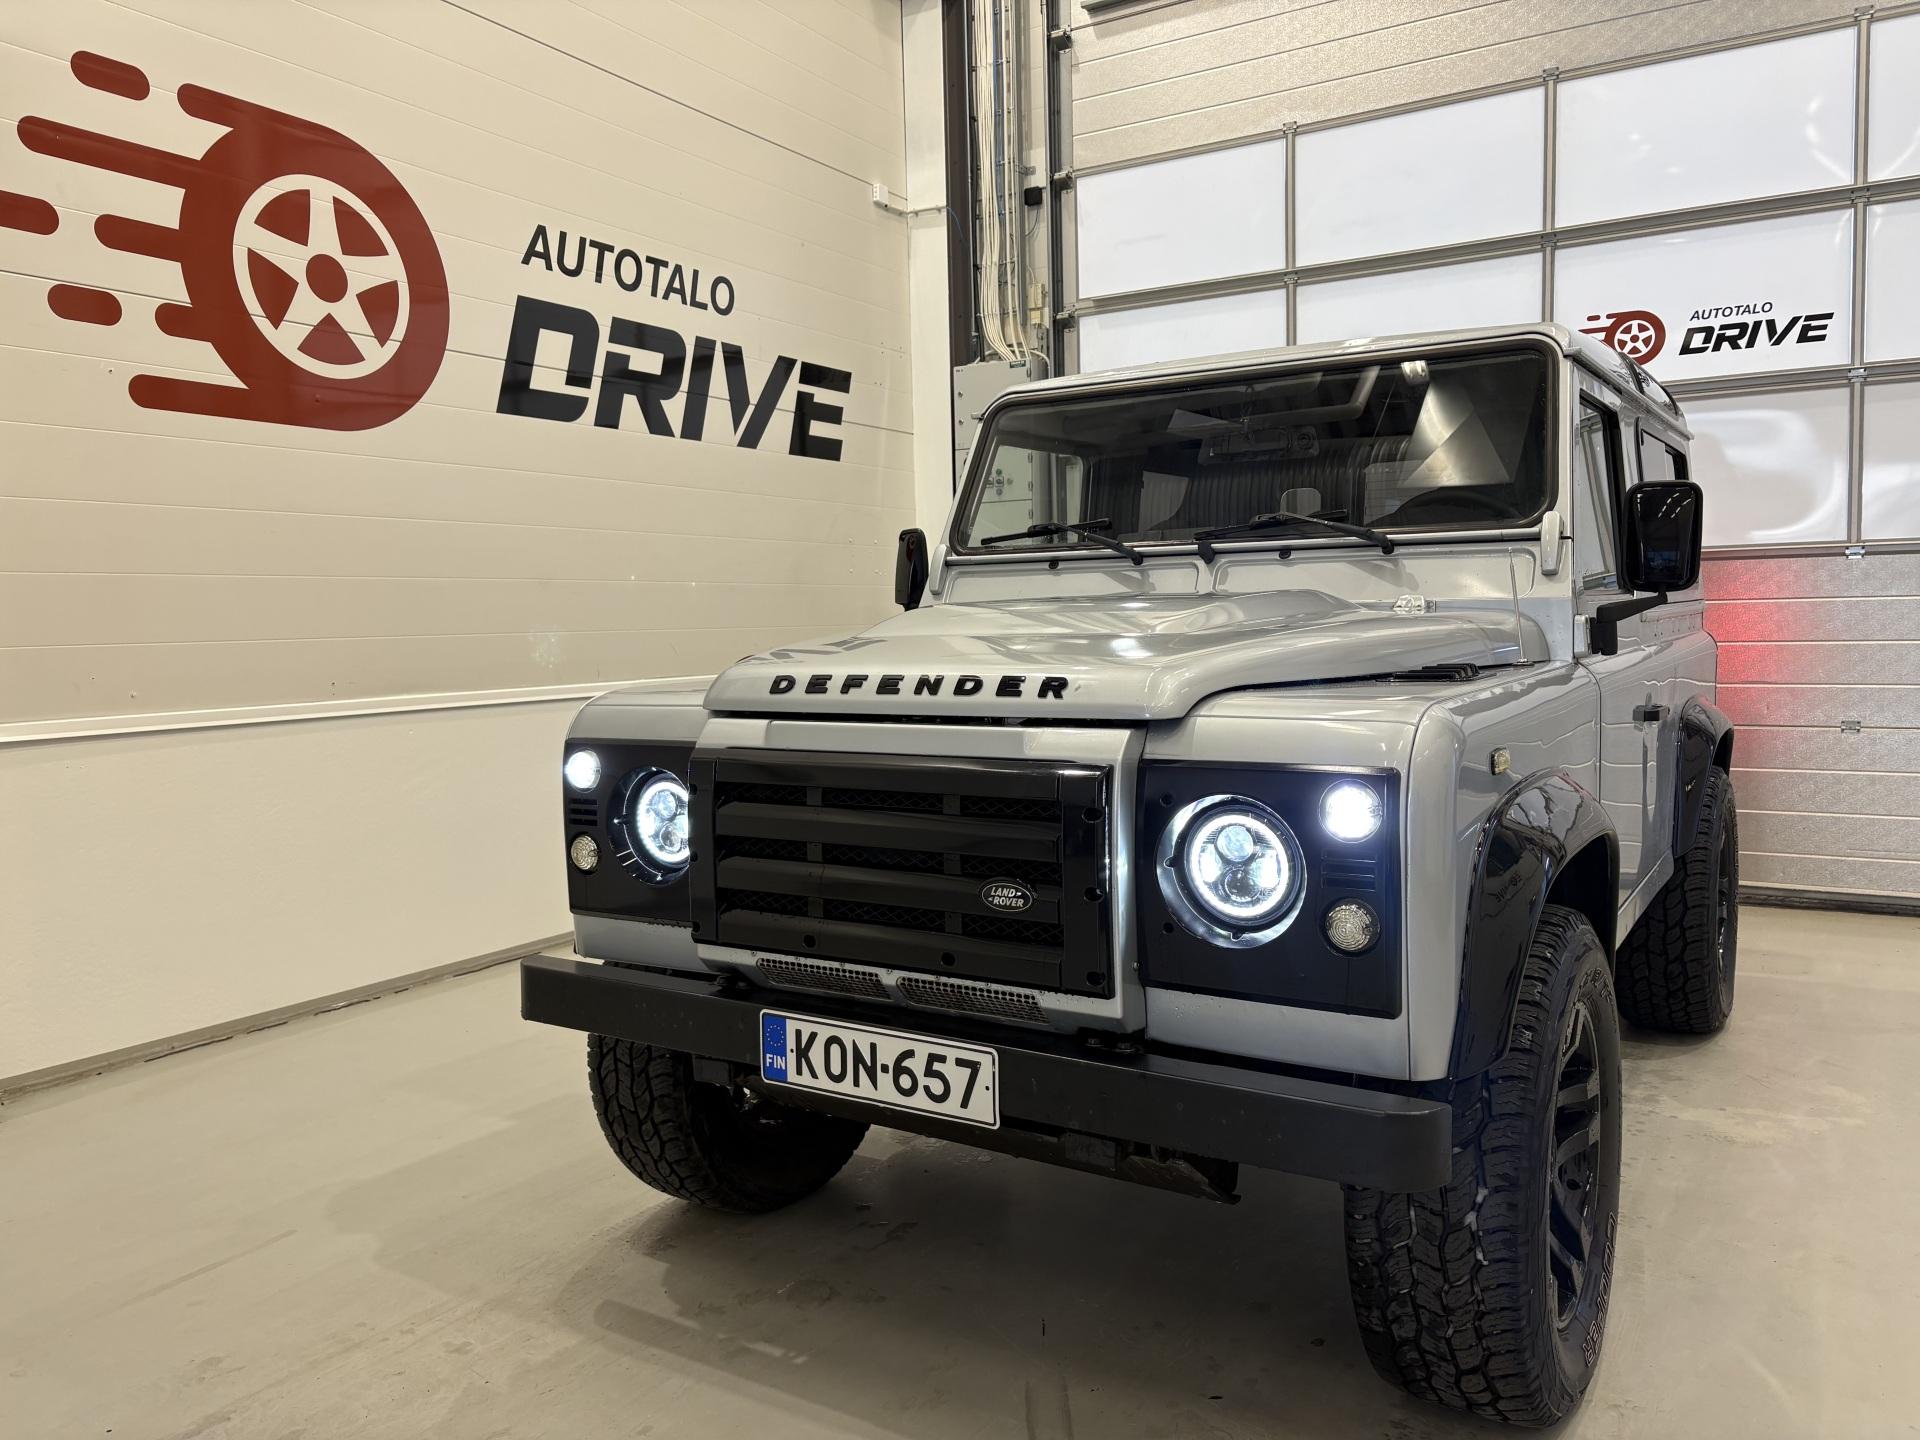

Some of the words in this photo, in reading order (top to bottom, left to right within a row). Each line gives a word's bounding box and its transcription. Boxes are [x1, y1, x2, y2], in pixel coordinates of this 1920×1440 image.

[521, 224, 735, 316] AUTOTALO
[1679, 312, 1835, 356] DRIVE
[1689, 301, 1773, 322] AUTOTALO
[496, 294, 852, 462] DRIVE
[769, 674, 1069, 699] DEFENDER
[766, 1053, 786, 1071] FIN
[795, 1028, 982, 1110] KON-657
